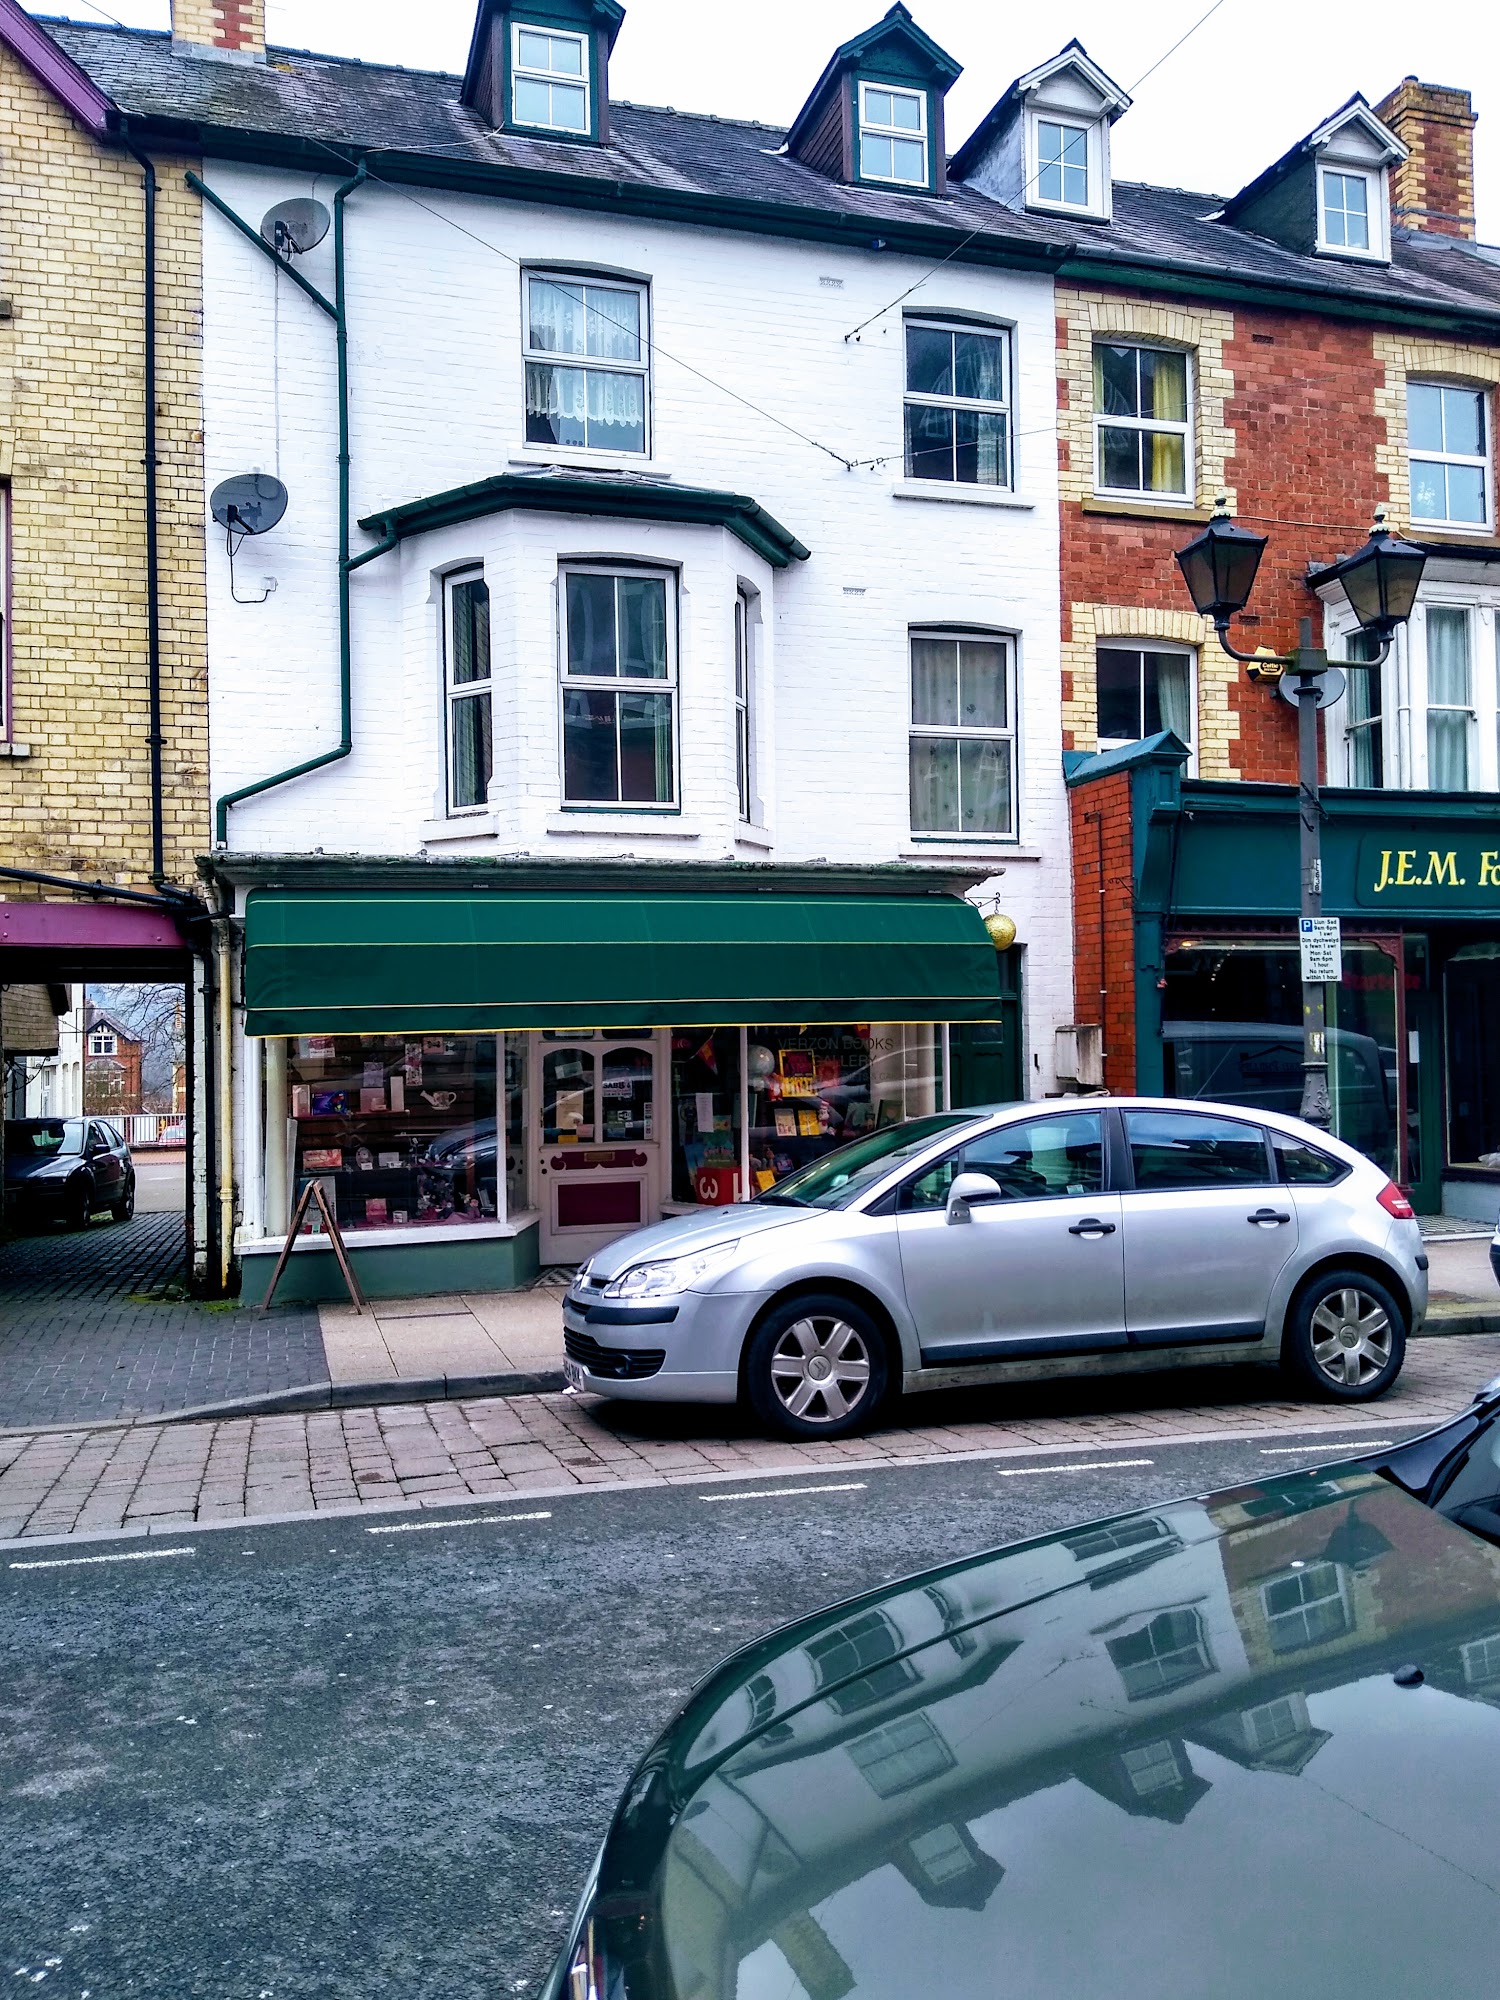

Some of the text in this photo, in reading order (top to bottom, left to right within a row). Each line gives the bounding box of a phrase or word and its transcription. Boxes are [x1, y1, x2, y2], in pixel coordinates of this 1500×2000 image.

[1374, 850, 1466, 892] J.E.M.
[1303, 920, 1311, 931] P
[777, 1037, 894, 1050] VERZON BOOKS
